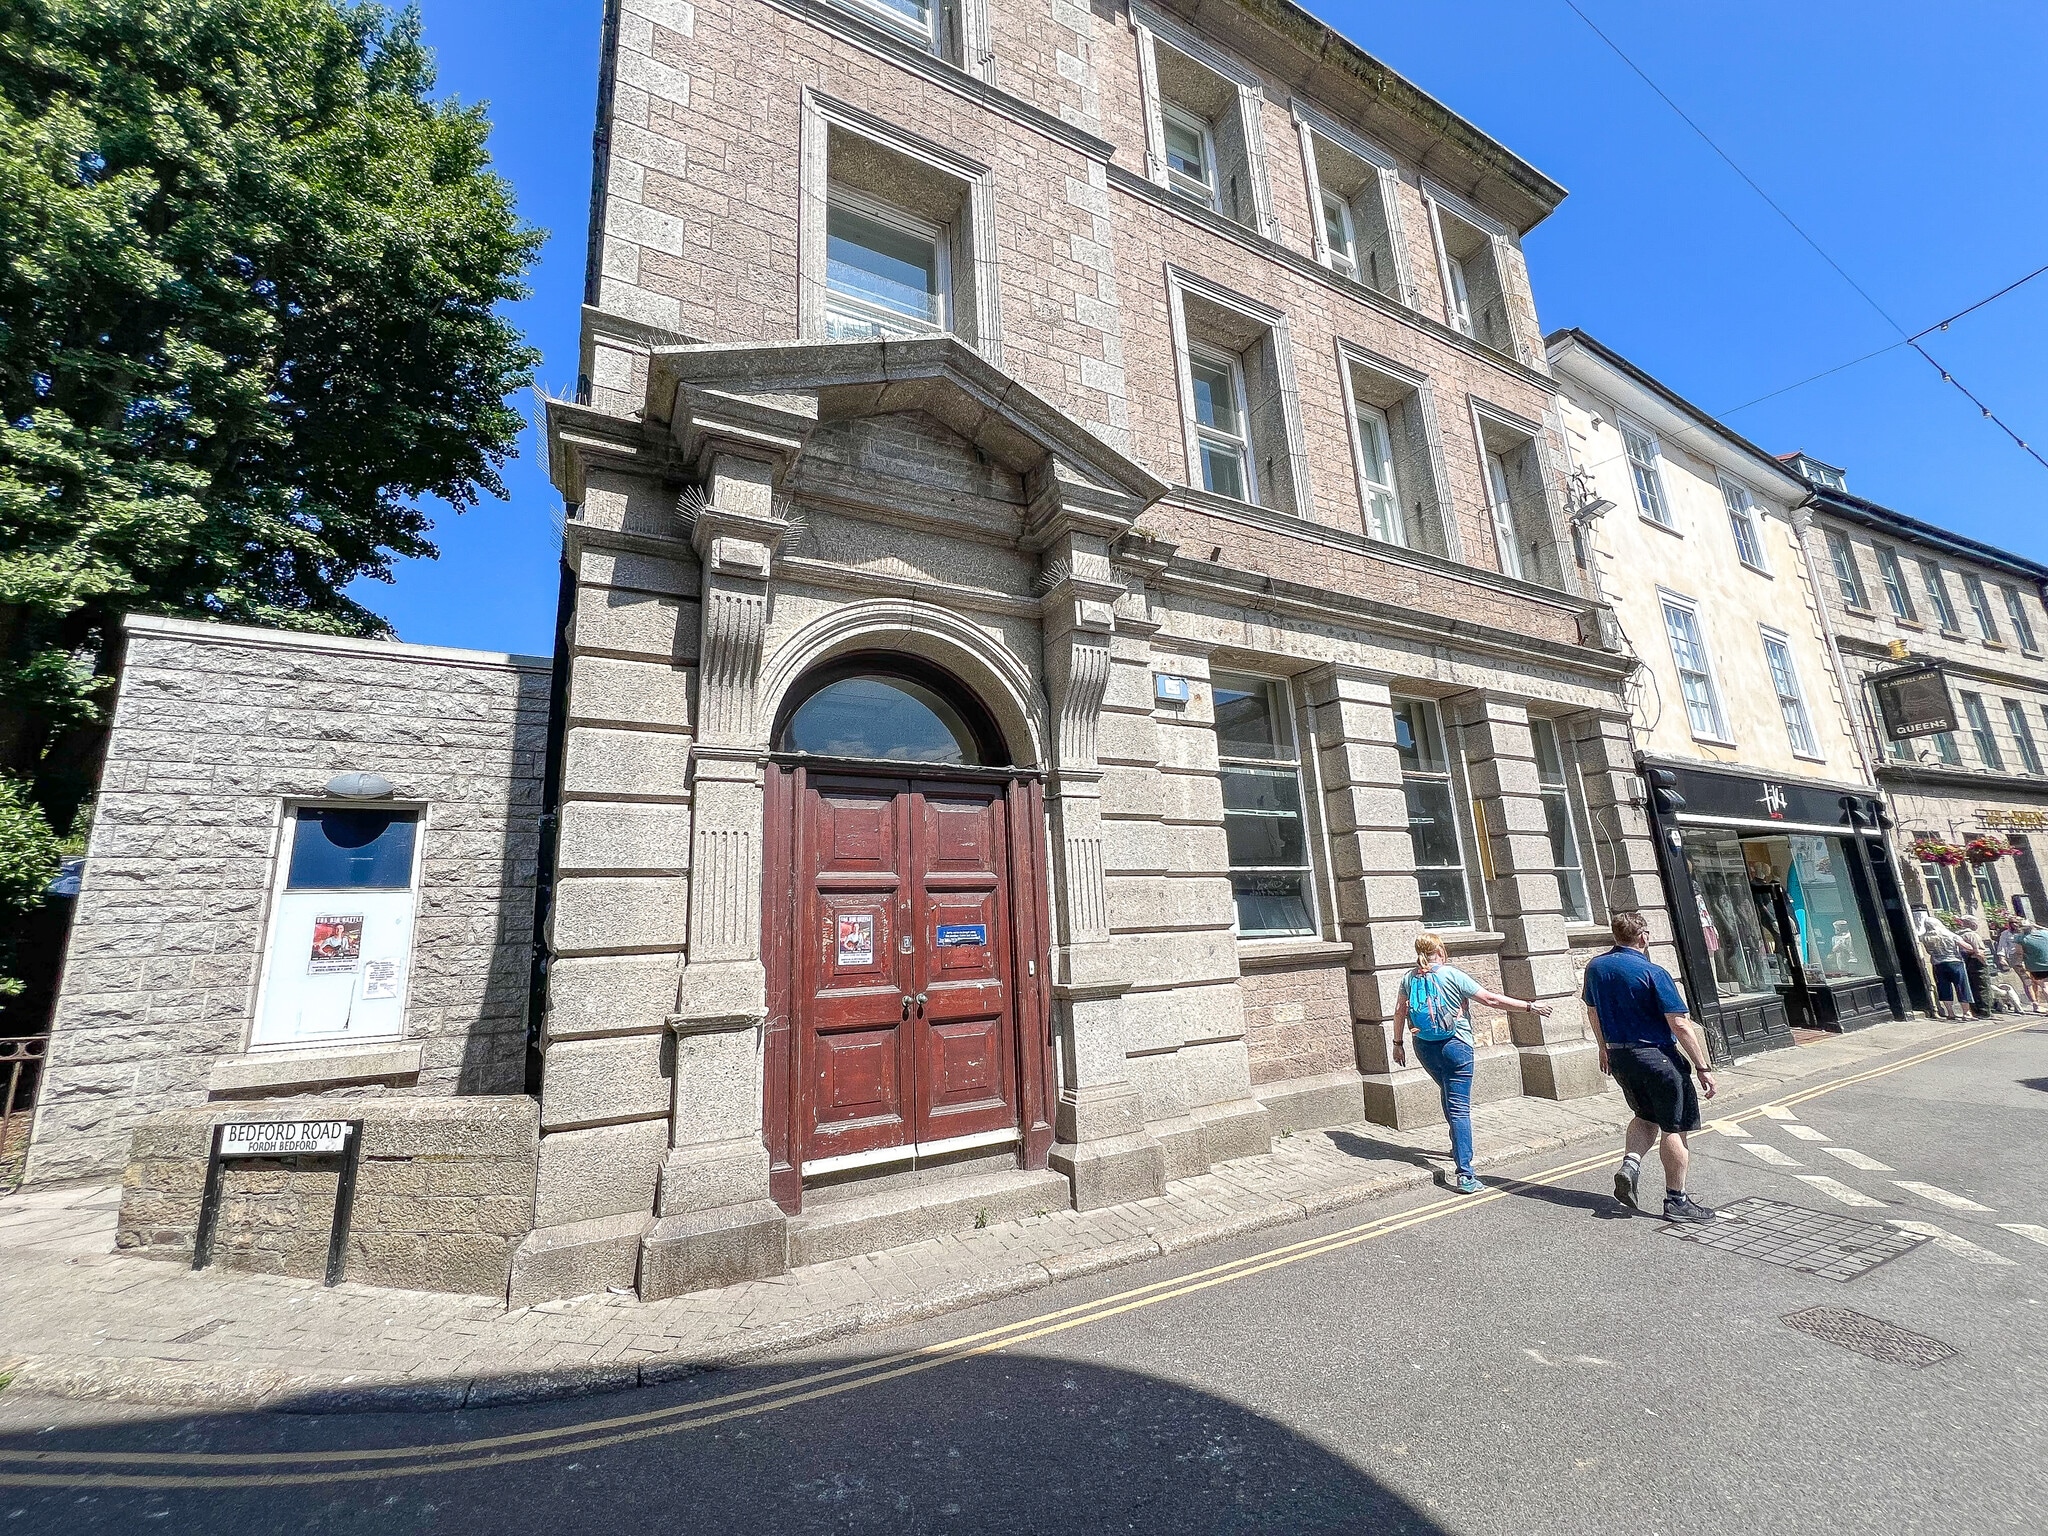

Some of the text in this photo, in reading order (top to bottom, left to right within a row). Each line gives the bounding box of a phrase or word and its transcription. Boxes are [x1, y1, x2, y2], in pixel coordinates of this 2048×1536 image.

[1918, 672, 1936, 680] ALES
[1896, 719, 1948, 734] QUEENS
[229, 1122, 342, 1141] BEDFORD ROAD
[248, 1140, 318, 1152] FORDH BEDFORD
